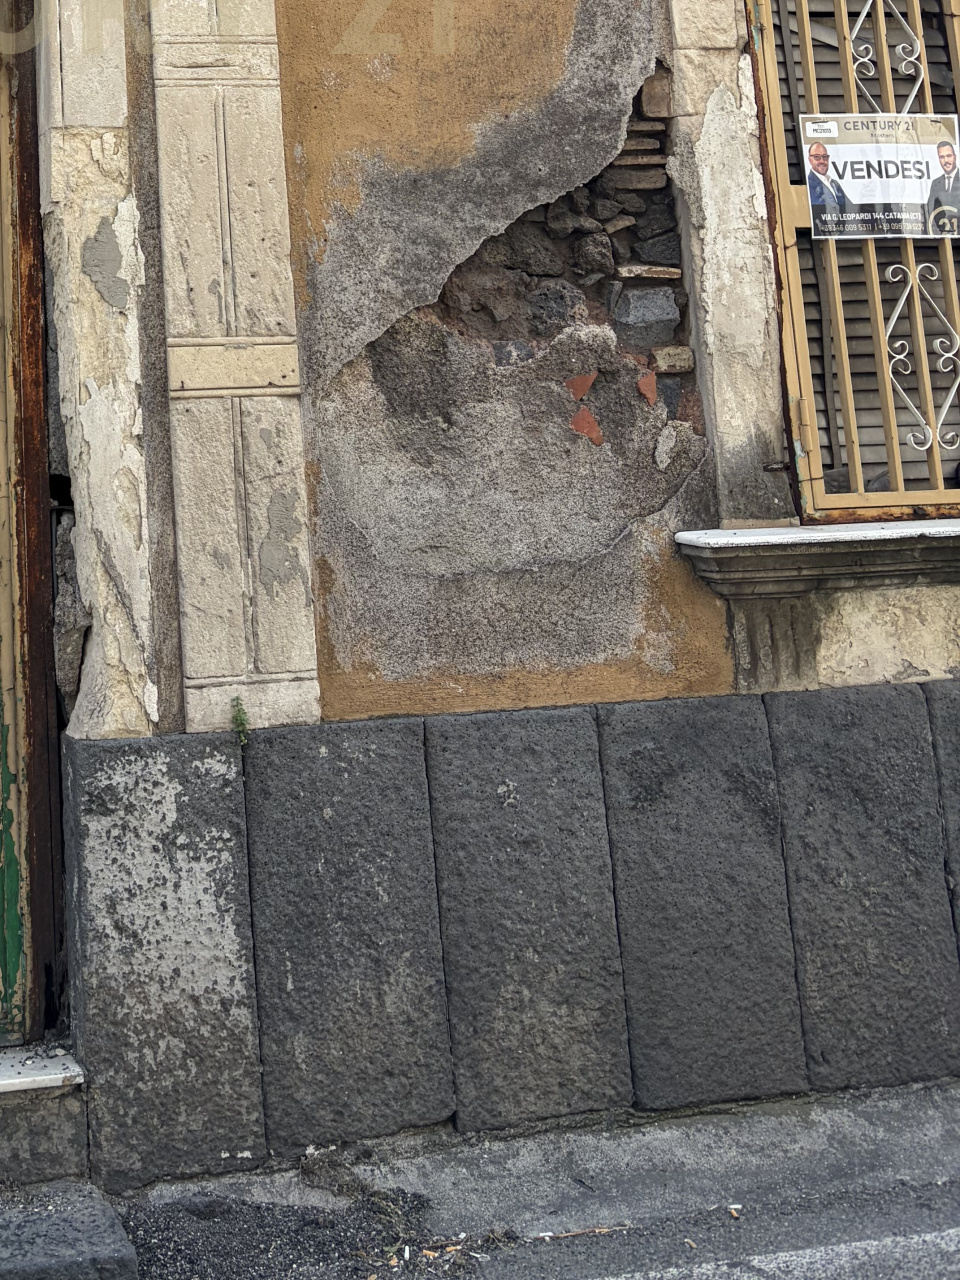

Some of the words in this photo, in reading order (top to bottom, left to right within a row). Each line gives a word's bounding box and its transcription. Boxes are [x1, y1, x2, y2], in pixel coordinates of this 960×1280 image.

[843, 120, 902, 131] CENTURY
[904, 121, 915, 131] 21
[831, 160, 931, 180] VENDESI
[821, 213, 831, 221] VIA
[839, 212, 872, 221] LEOPARDI
[872, 212, 884, 220] 144
[844, 223, 858, 231] 009
[858, 223, 872, 231] 5311
